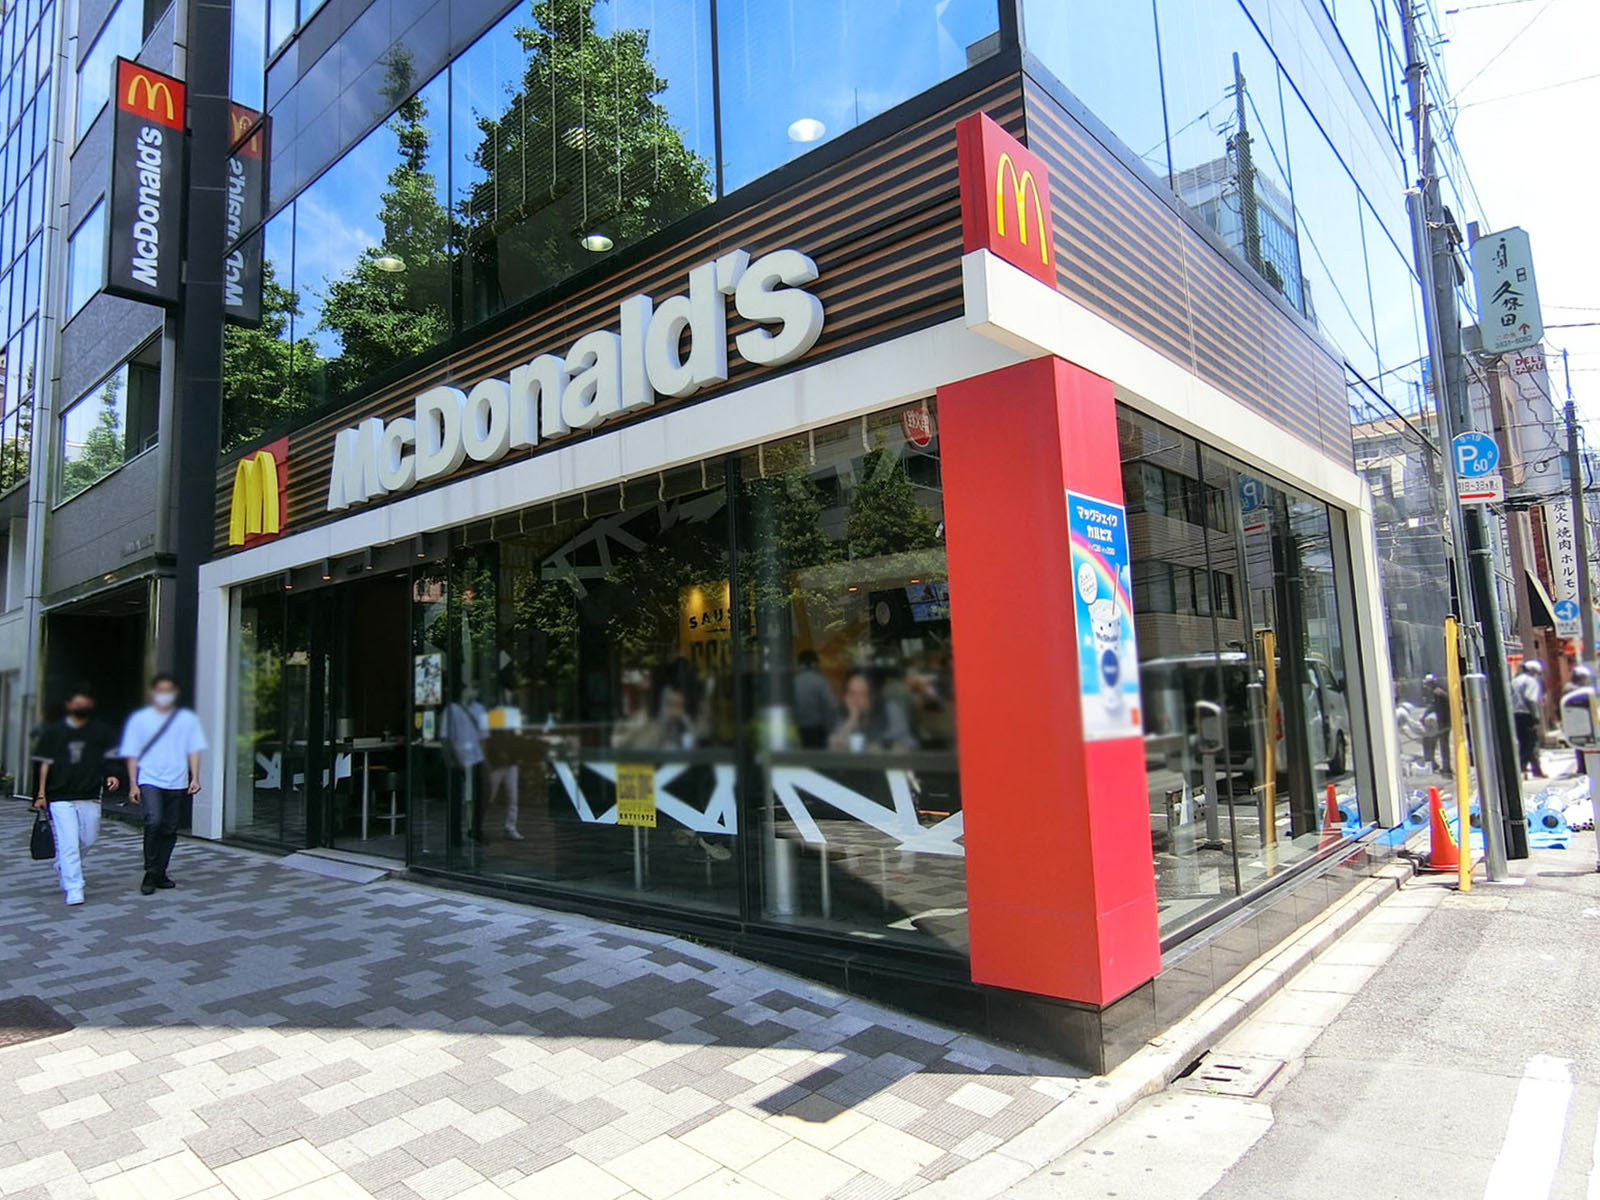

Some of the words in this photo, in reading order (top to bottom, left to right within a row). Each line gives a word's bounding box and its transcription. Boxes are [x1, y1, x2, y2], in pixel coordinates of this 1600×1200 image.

[131, 125, 163, 288] McDonald's
[326, 247, 825, 512] McDonald's
[1458, 445, 1478, 473] P
[1076, 505, 1118, 528] マックシェイク
[1086, 525, 1113, 543] カルピス
